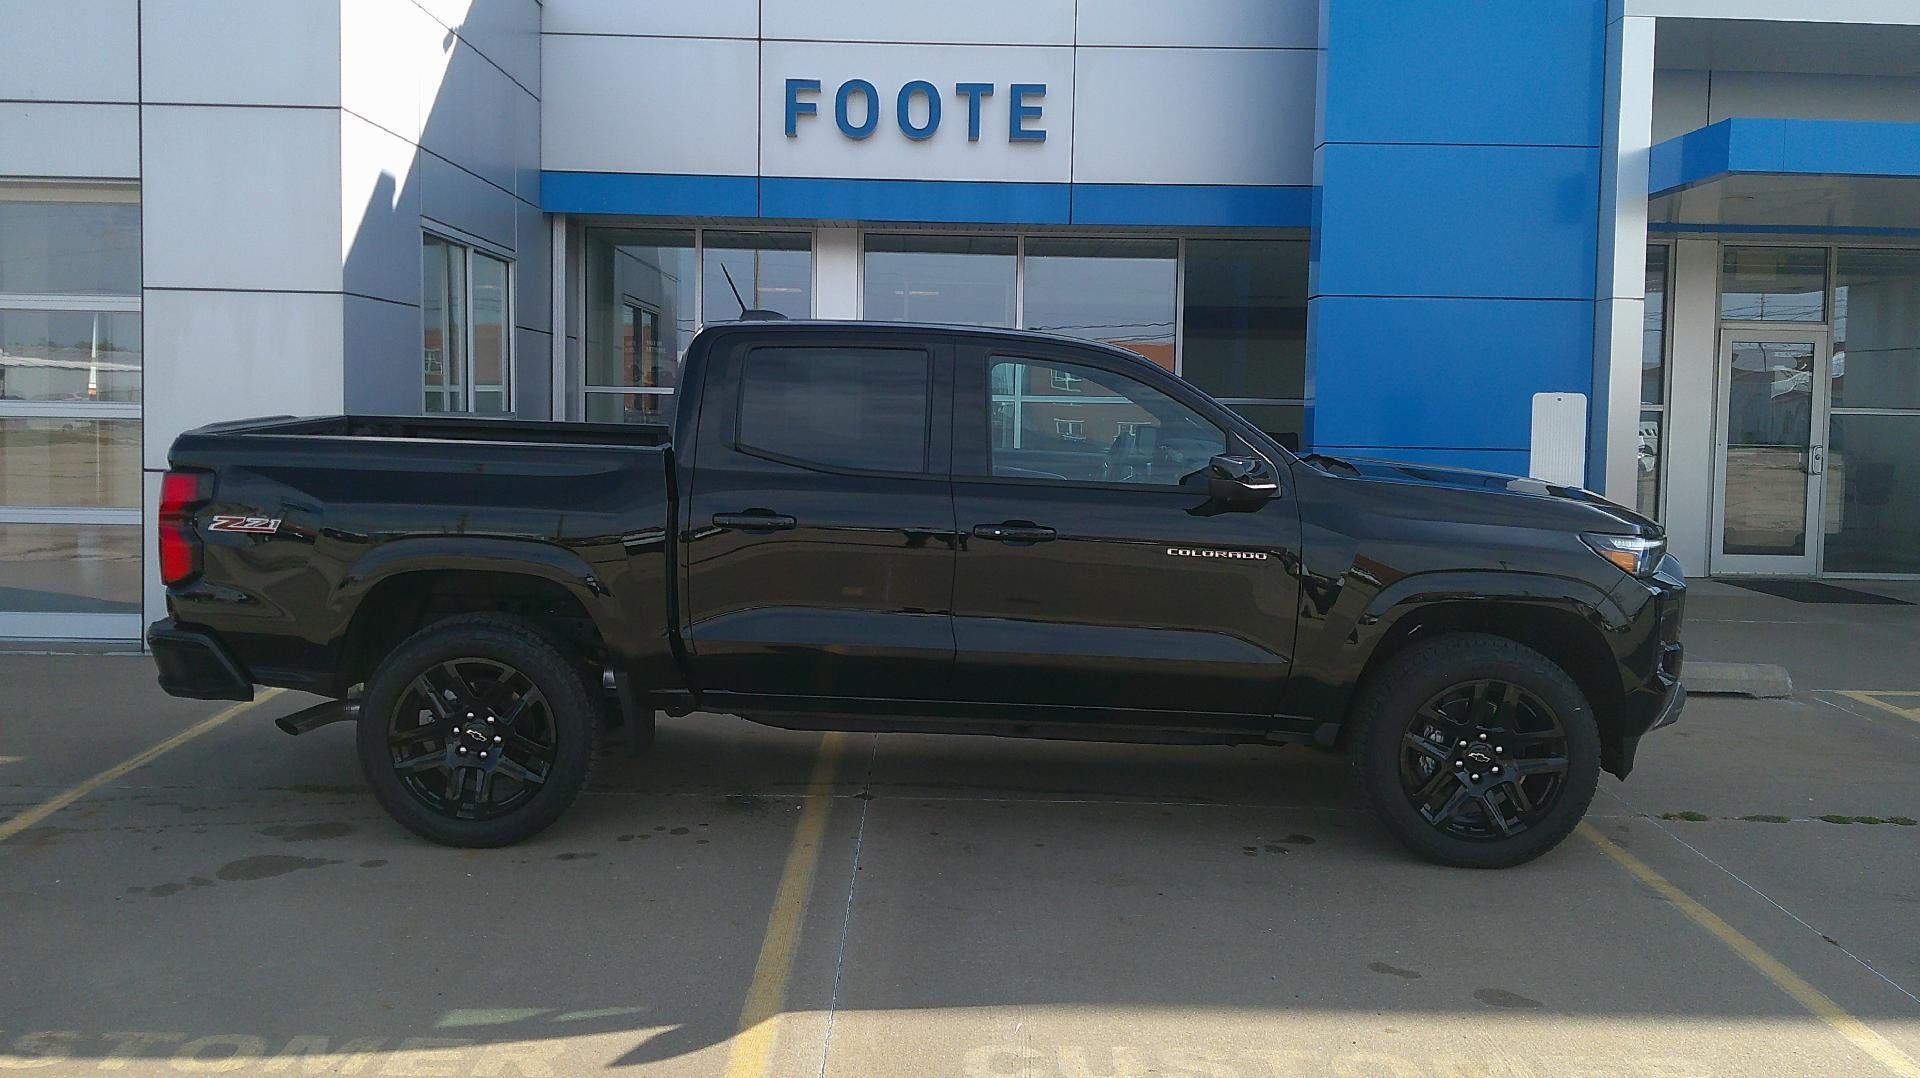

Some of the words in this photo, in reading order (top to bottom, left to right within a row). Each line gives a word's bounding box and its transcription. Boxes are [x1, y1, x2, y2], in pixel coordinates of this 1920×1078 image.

[784, 78, 1047, 143] FOOTE
[207, 515, 282, 534] Z71
[1166, 548, 1268, 560] COLORADO
